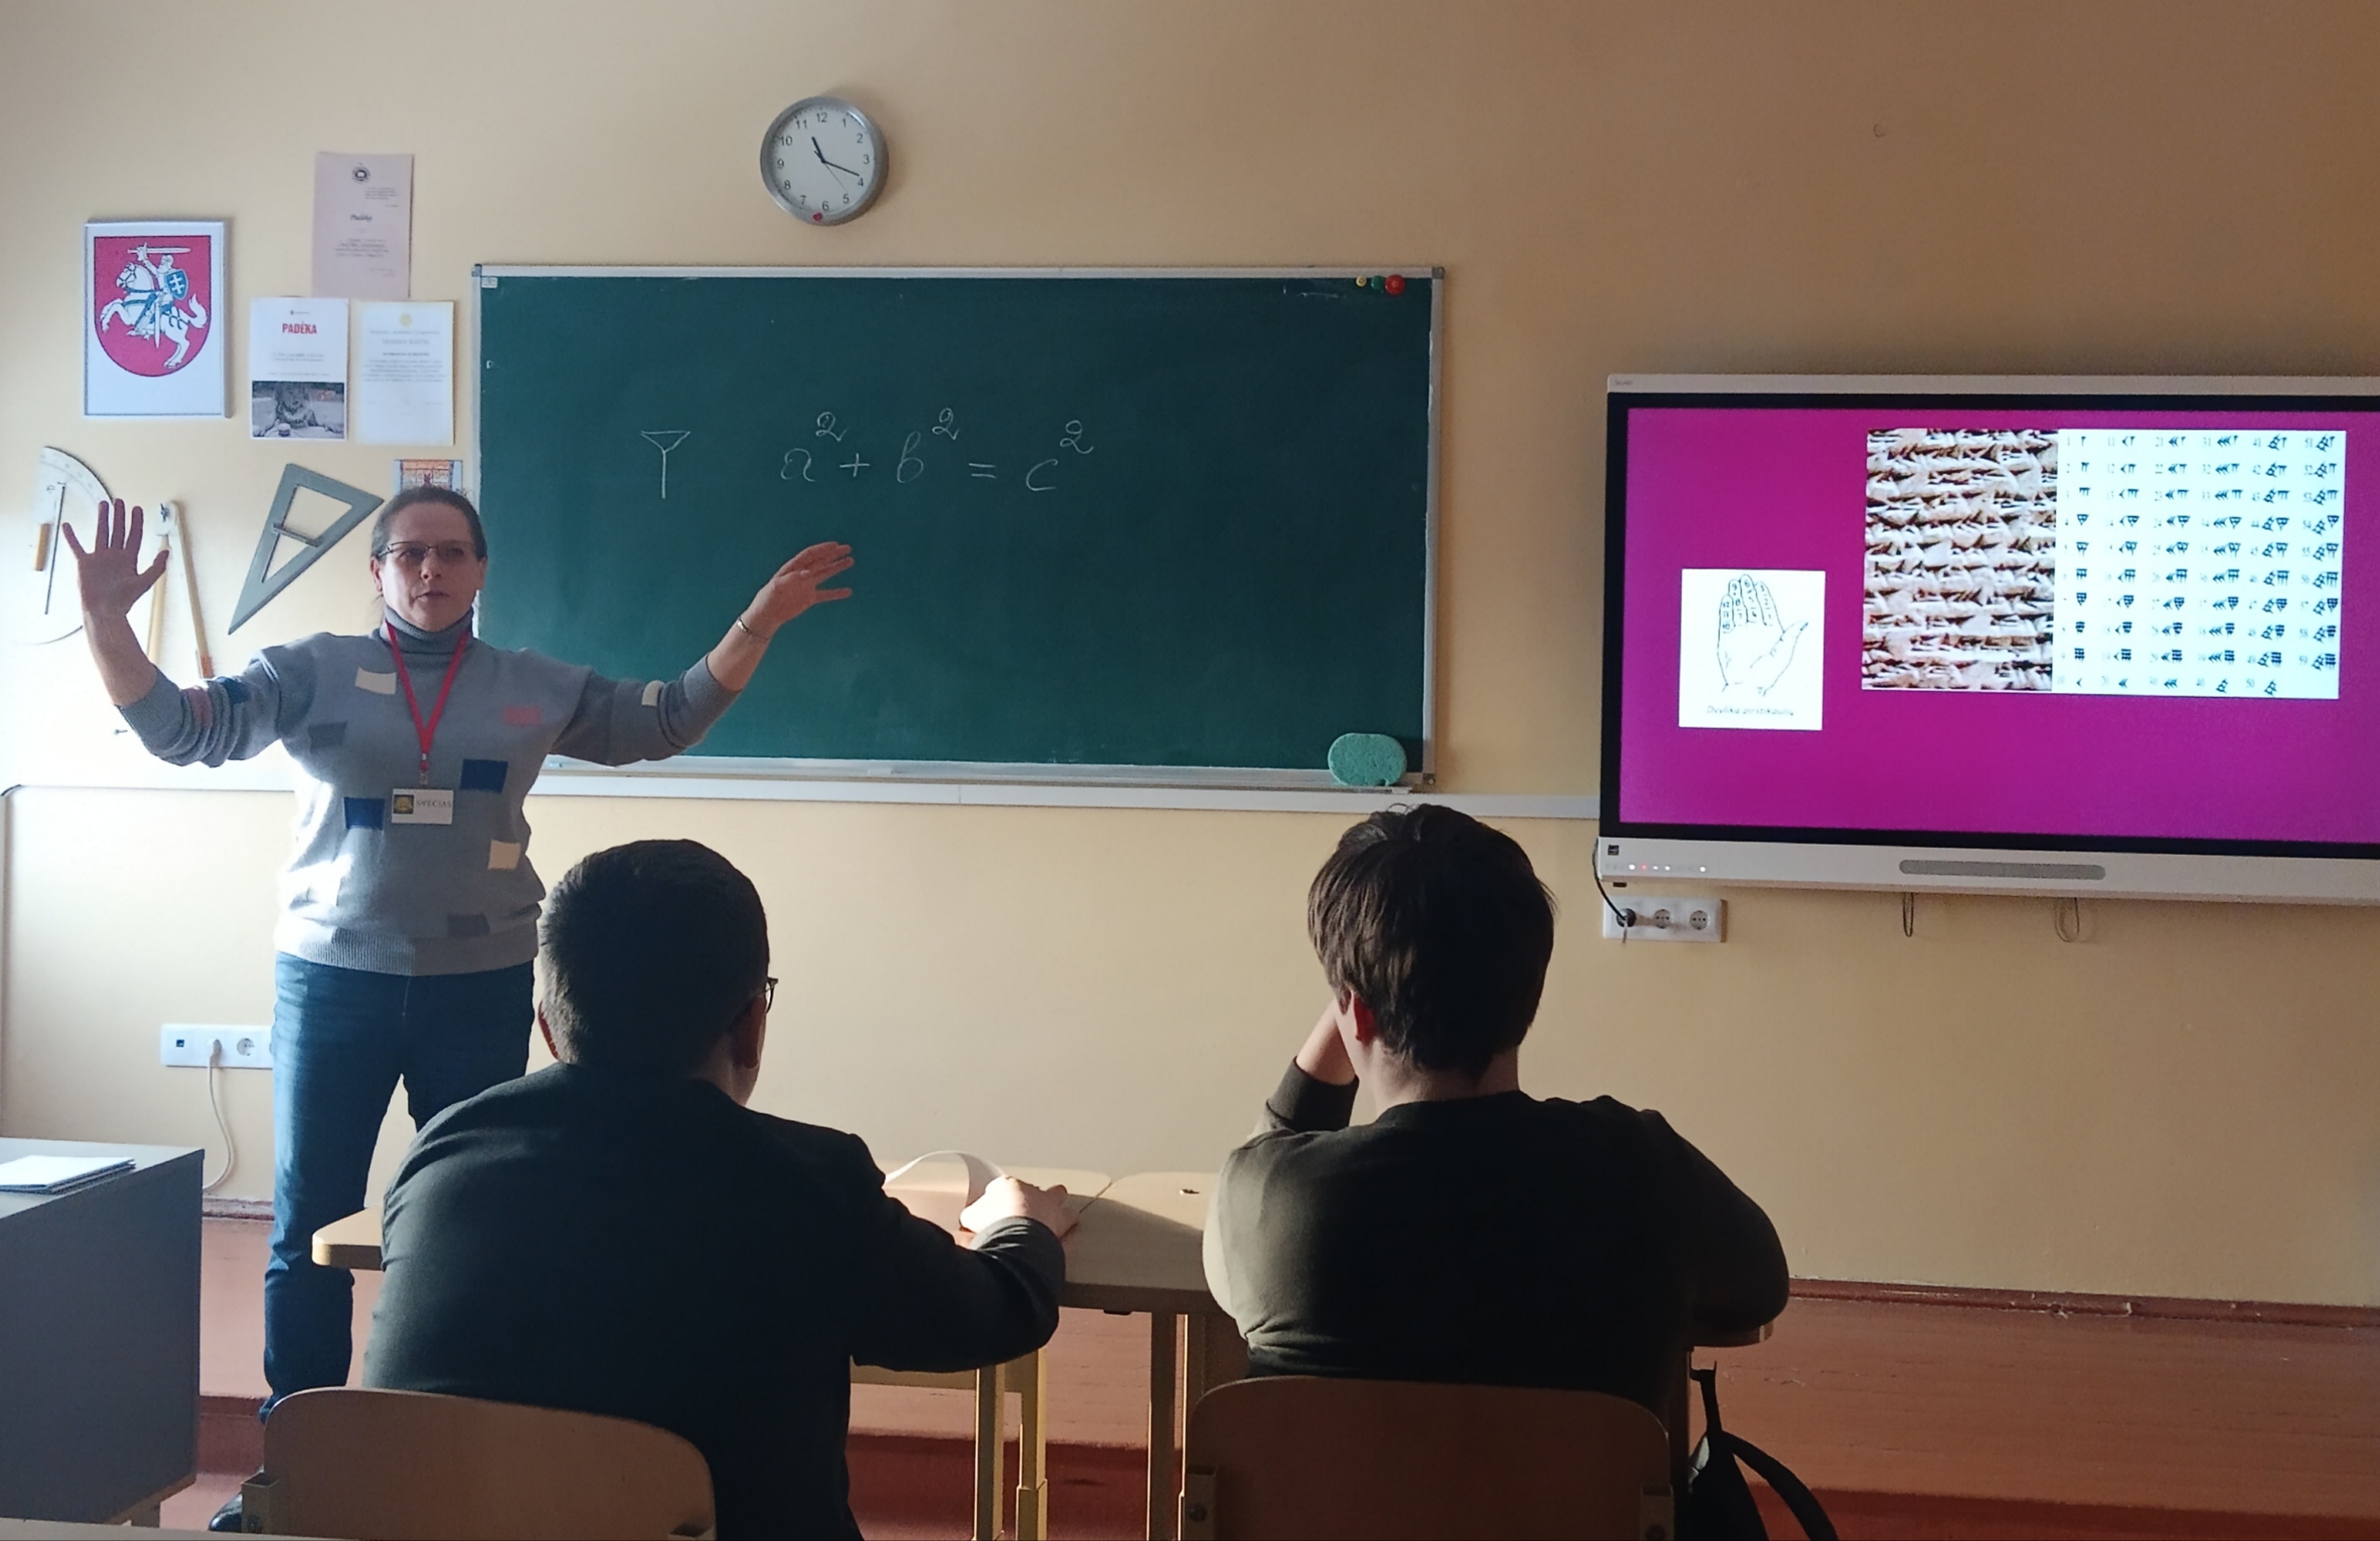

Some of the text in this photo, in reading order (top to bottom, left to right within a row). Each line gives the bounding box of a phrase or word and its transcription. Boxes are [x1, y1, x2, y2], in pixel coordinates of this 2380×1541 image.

[816, 112, 827, 123] 12
[796, 119, 807, 130] 11
[780, 136, 793, 146] 10
[857, 133, 863, 144] 2
[777, 159, 784, 169] 9
[863, 154, 870, 165] 3
[784, 180, 791, 190] 8
[858, 177, 864, 187] 4
[800, 195, 807, 206] 7
[843, 193, 849, 203] 5
[822, 201, 829, 211] 6
[282, 320, 317, 335] PADĖKA
